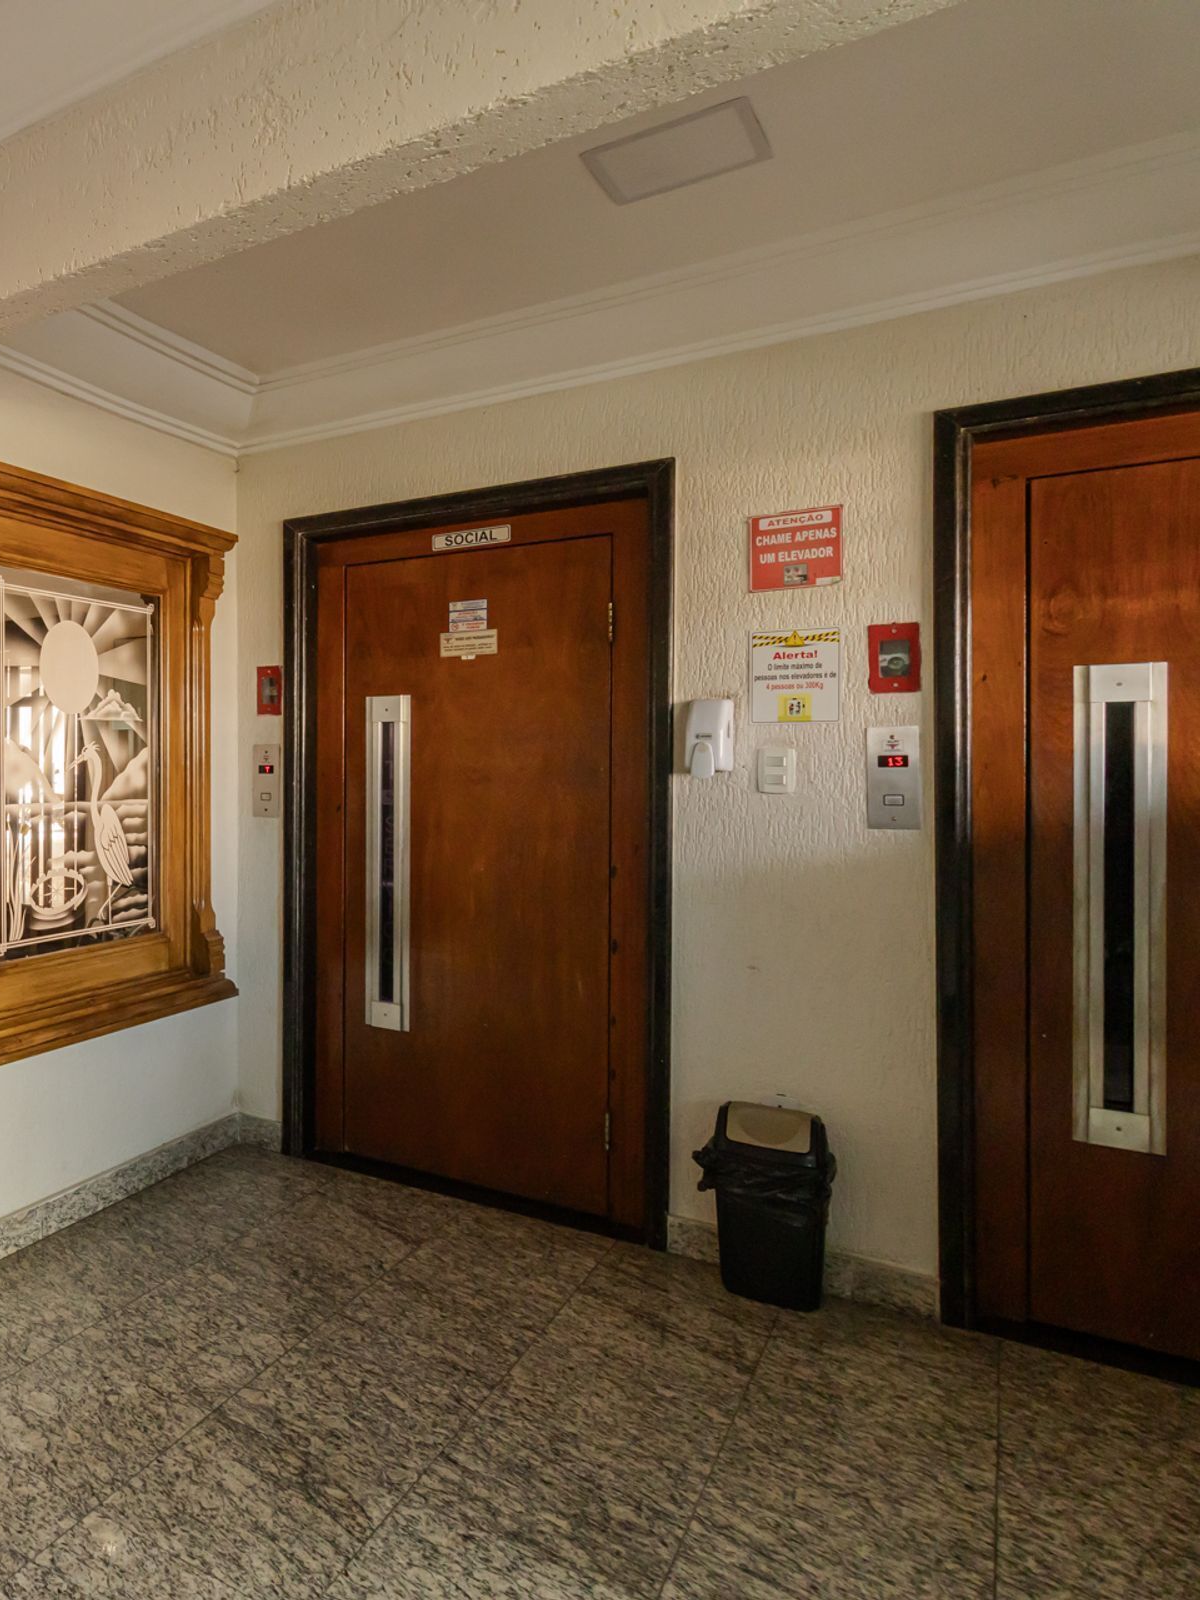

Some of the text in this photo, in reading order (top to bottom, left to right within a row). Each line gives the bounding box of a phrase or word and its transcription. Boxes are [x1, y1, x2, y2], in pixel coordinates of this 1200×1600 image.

[445, 530, 497, 547] SOCIAL
[756, 527, 837, 546] CHAME APENAS
[759, 546, 834, 564] UM ELEVADOR
[773, 650, 818, 660] Alerta!
[791, 671, 822, 680] elevadores
[771, 683, 795, 691] pessoas
[887, 757, 904, 767] 13
